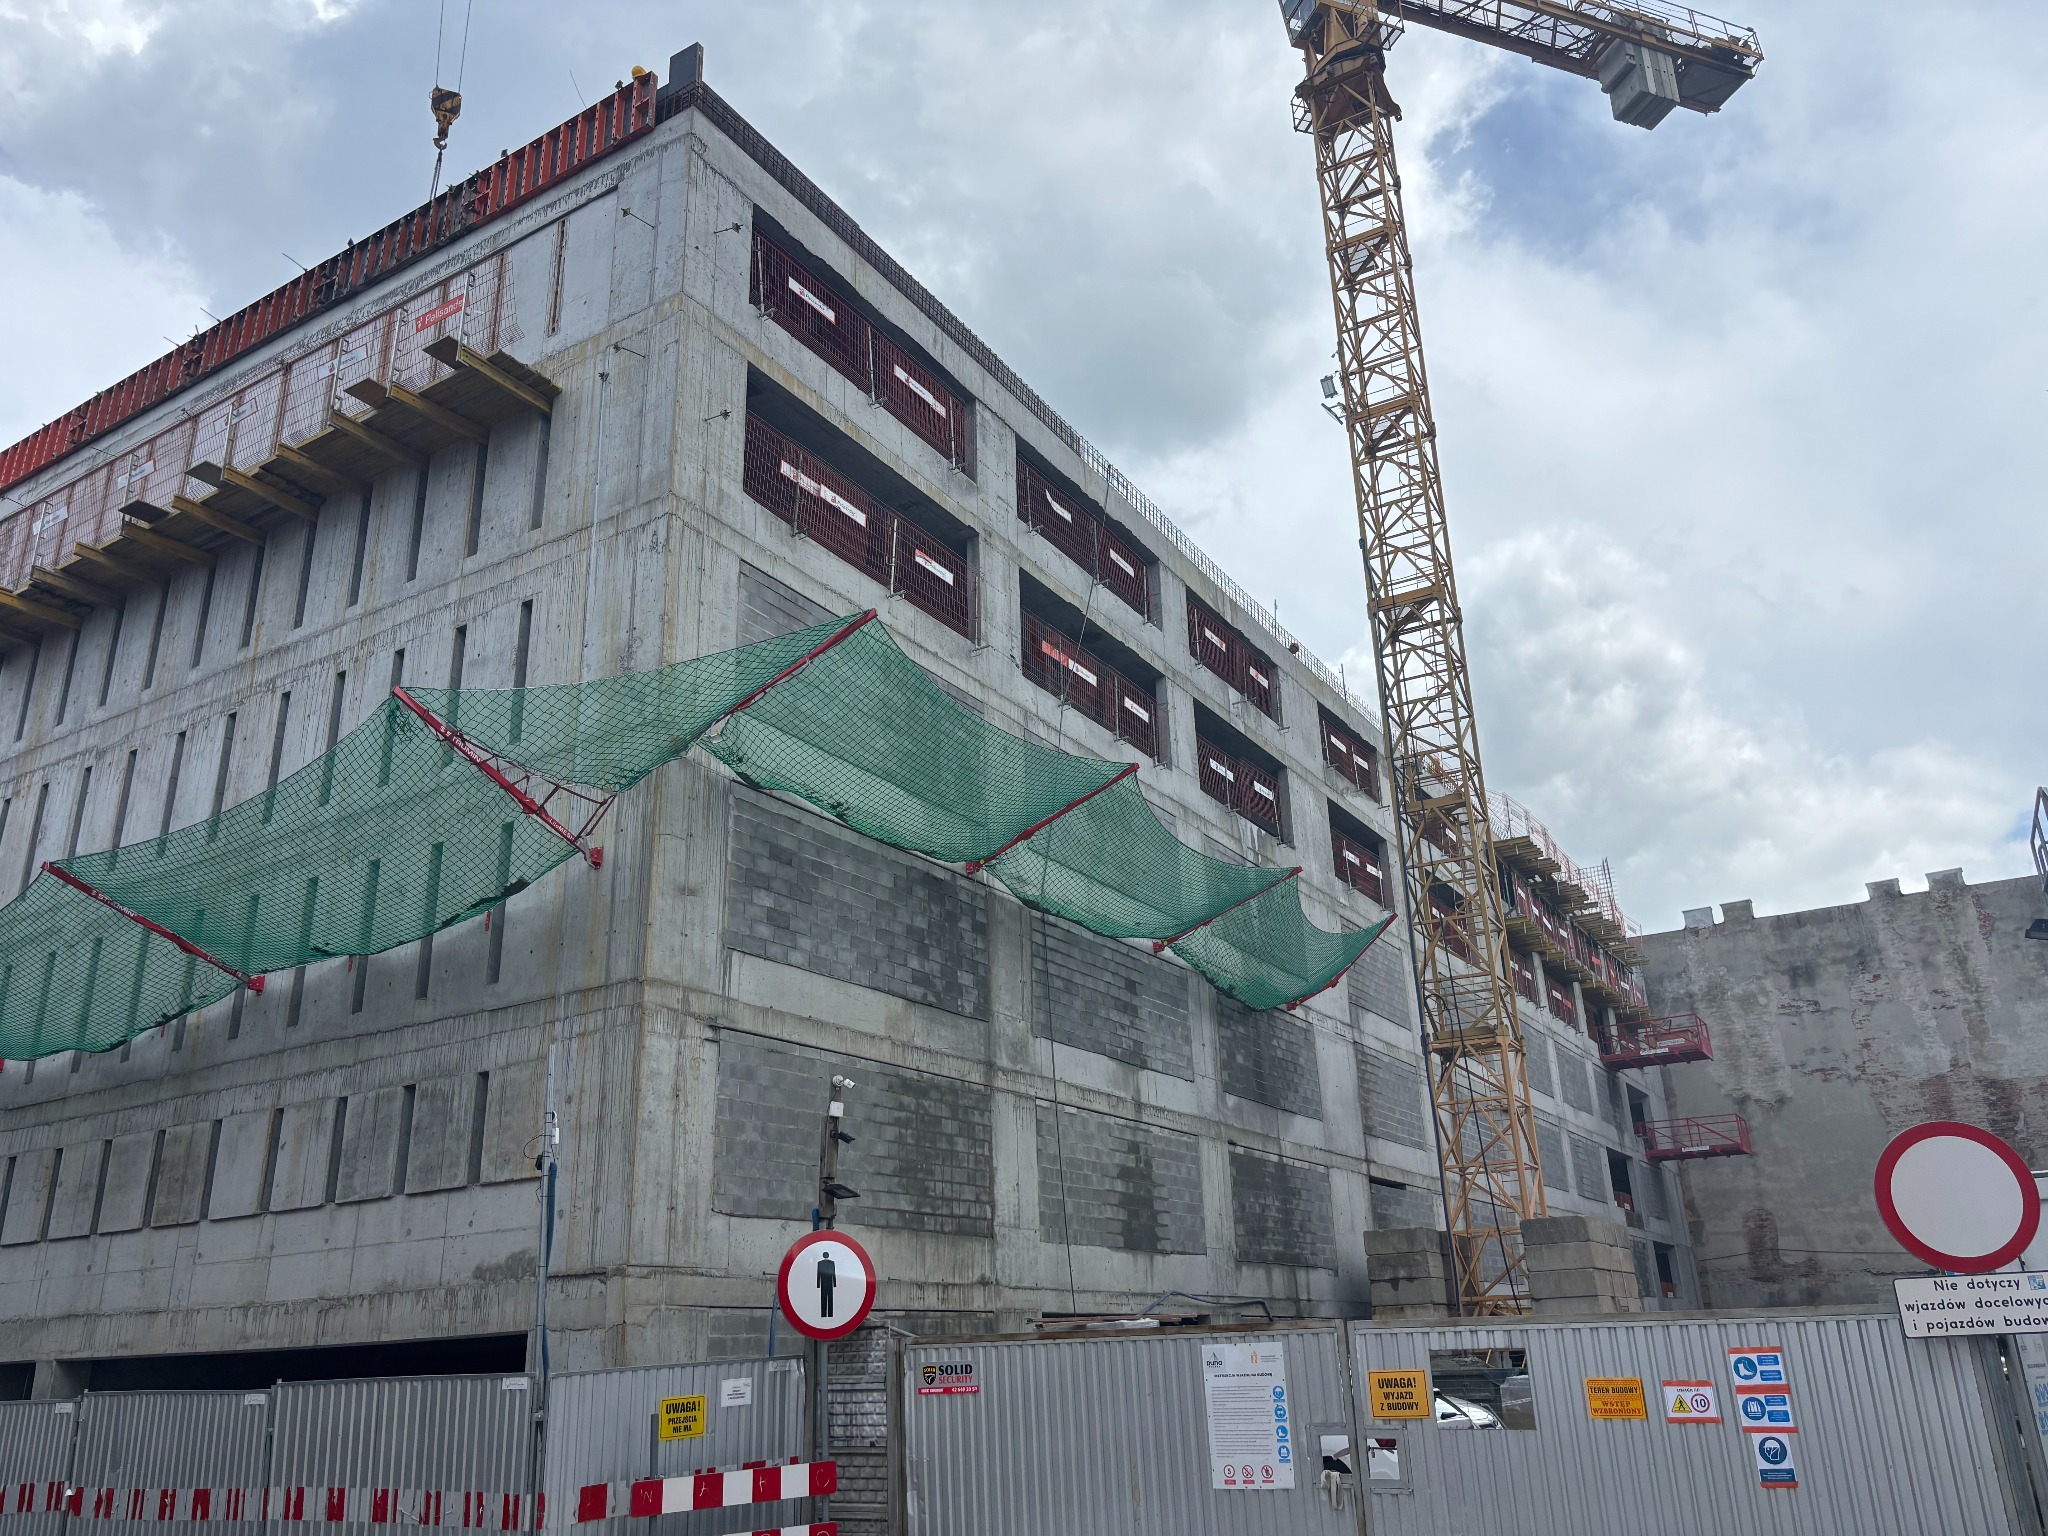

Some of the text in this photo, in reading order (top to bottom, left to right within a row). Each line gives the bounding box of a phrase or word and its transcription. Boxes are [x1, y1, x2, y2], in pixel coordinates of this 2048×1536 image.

[425, 299, 464, 325] Palisande
[1933, 1278, 2021, 1292] Nie dotyczy
[1904, 1298, 1966, 1315] wjazdów
[1913, 1319, 1918, 1331] i
[1926, 1316, 1996, 1333] pojazdów
[938, 1364, 973, 1376] SOLID
[939, 1375, 973, 1384] SECURITY
[1378, 1377, 1416, 1389] UWAGA!
[1383, 1391, 1413, 1400] WYJAZD
[1590, 1386, 1638, 1394] TEREN BUDOWY
[1380, 1401, 1419, 1411] Z BUDOWY
[1694, 1398, 1707, 1408] 10
[1592, 1407, 1642, 1415] WZBRONIONY
